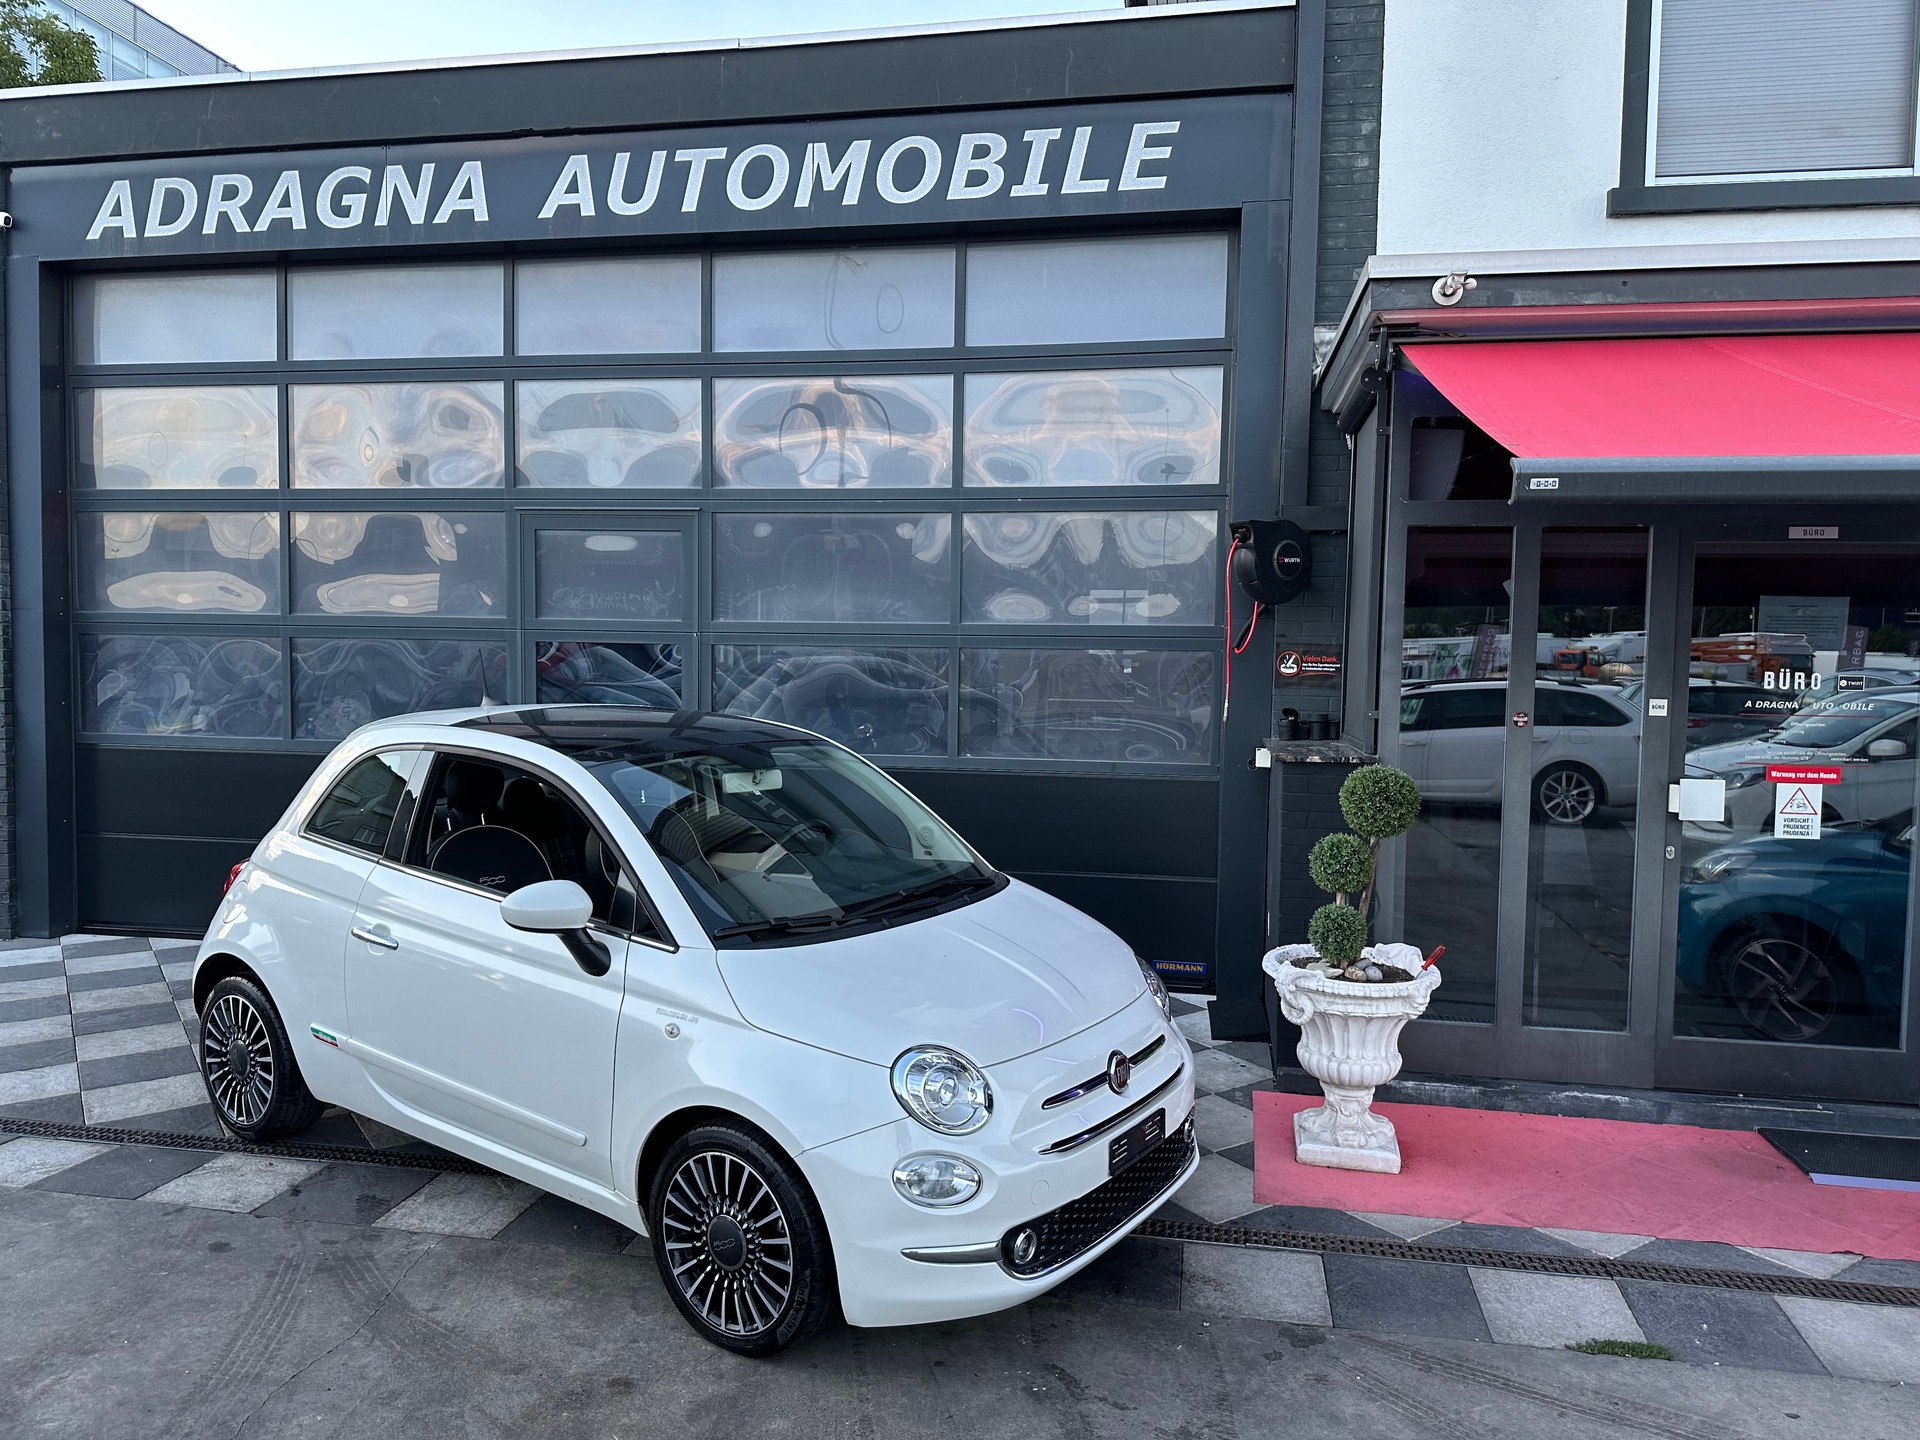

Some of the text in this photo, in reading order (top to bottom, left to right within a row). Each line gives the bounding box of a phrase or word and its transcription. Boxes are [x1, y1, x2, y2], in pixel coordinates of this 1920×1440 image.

[86, 121, 1181, 240] ADRAGNA AUTOMOBILE
[1803, 528, 1825, 536] BÜRO
[1763, 668, 1822, 690] BÜRO
